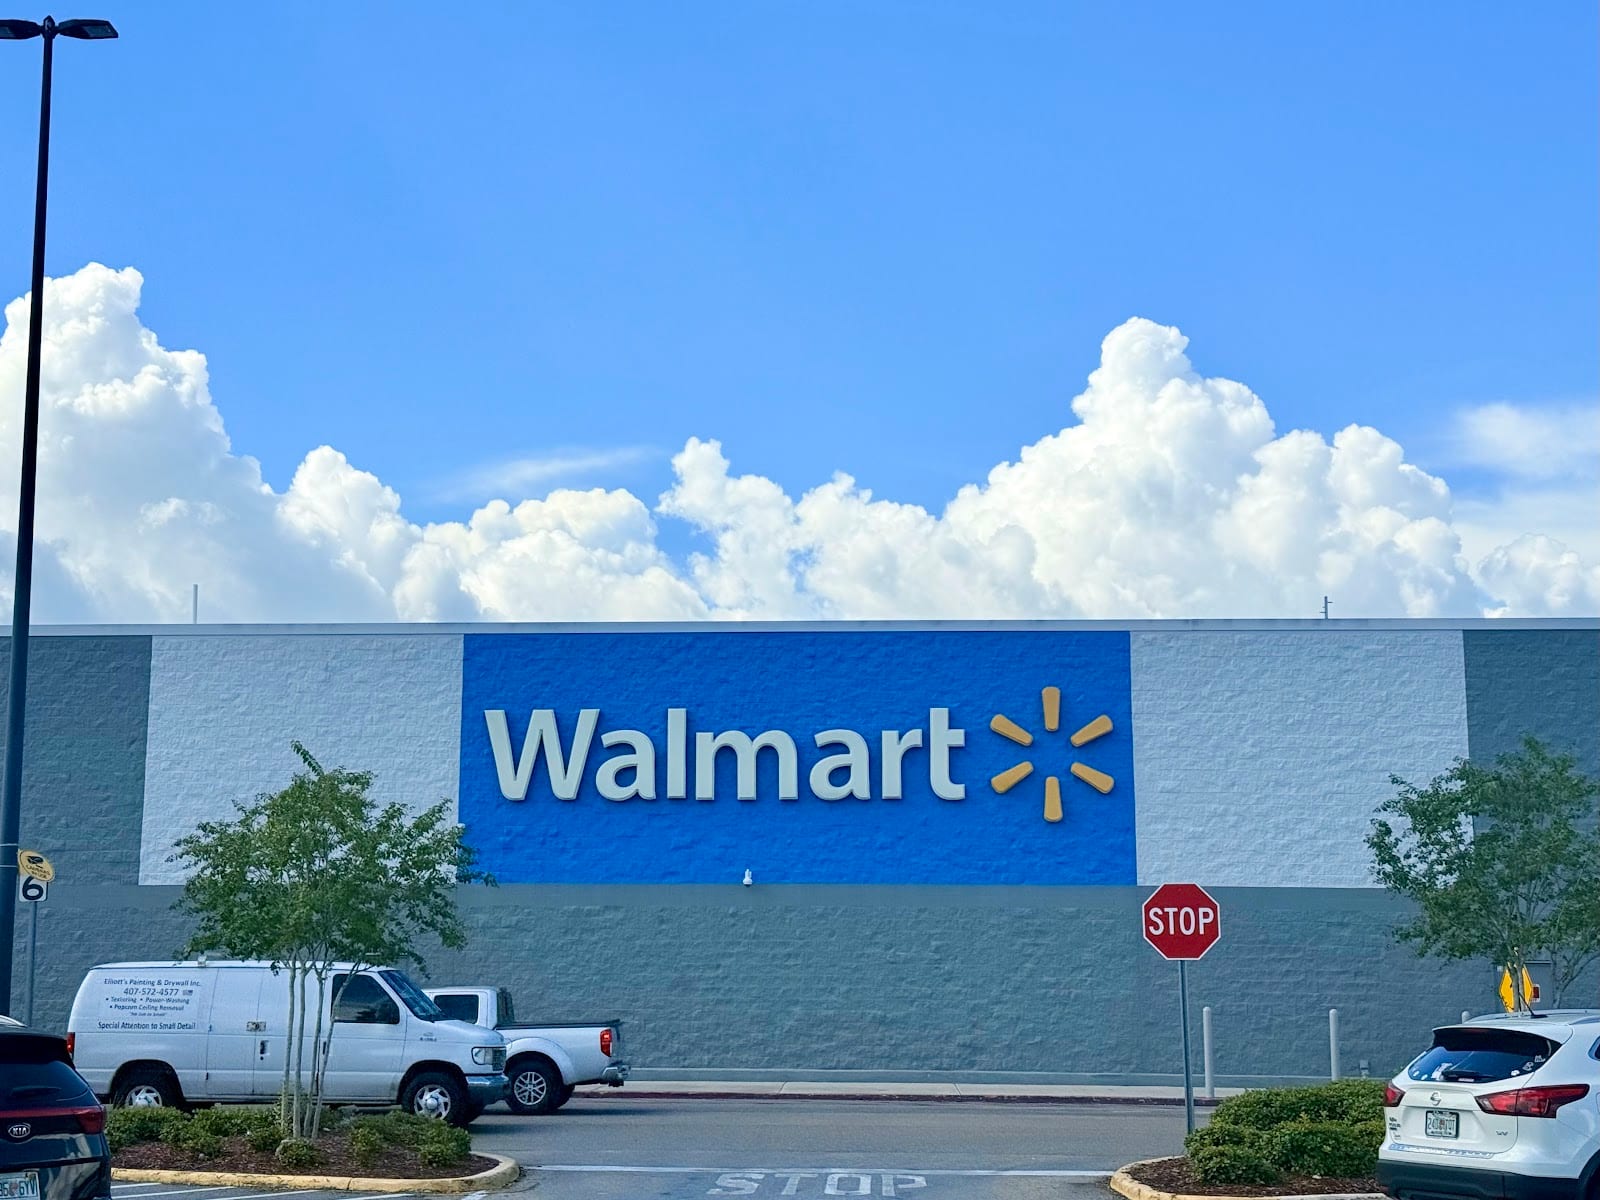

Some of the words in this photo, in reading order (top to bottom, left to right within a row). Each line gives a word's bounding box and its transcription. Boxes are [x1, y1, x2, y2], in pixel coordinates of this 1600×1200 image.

[484, 708, 965, 802] Walmart
[22, 876, 43, 900] 6
[1149, 907, 1215, 936] STOP
[123, 988, 178, 996] 407-572-4577
[129, 979, 155, 987] Painting
[164, 980, 188, 988] Drywall
[98, 1021, 120, 1030] Special
[121, 1021, 150, 1030] Attention
[151, 1022, 158, 1030] to
[159, 1022, 176, 1030] Small
[177, 1022, 196, 1030] Detail
[706, 1173, 928, 1197] STOP
